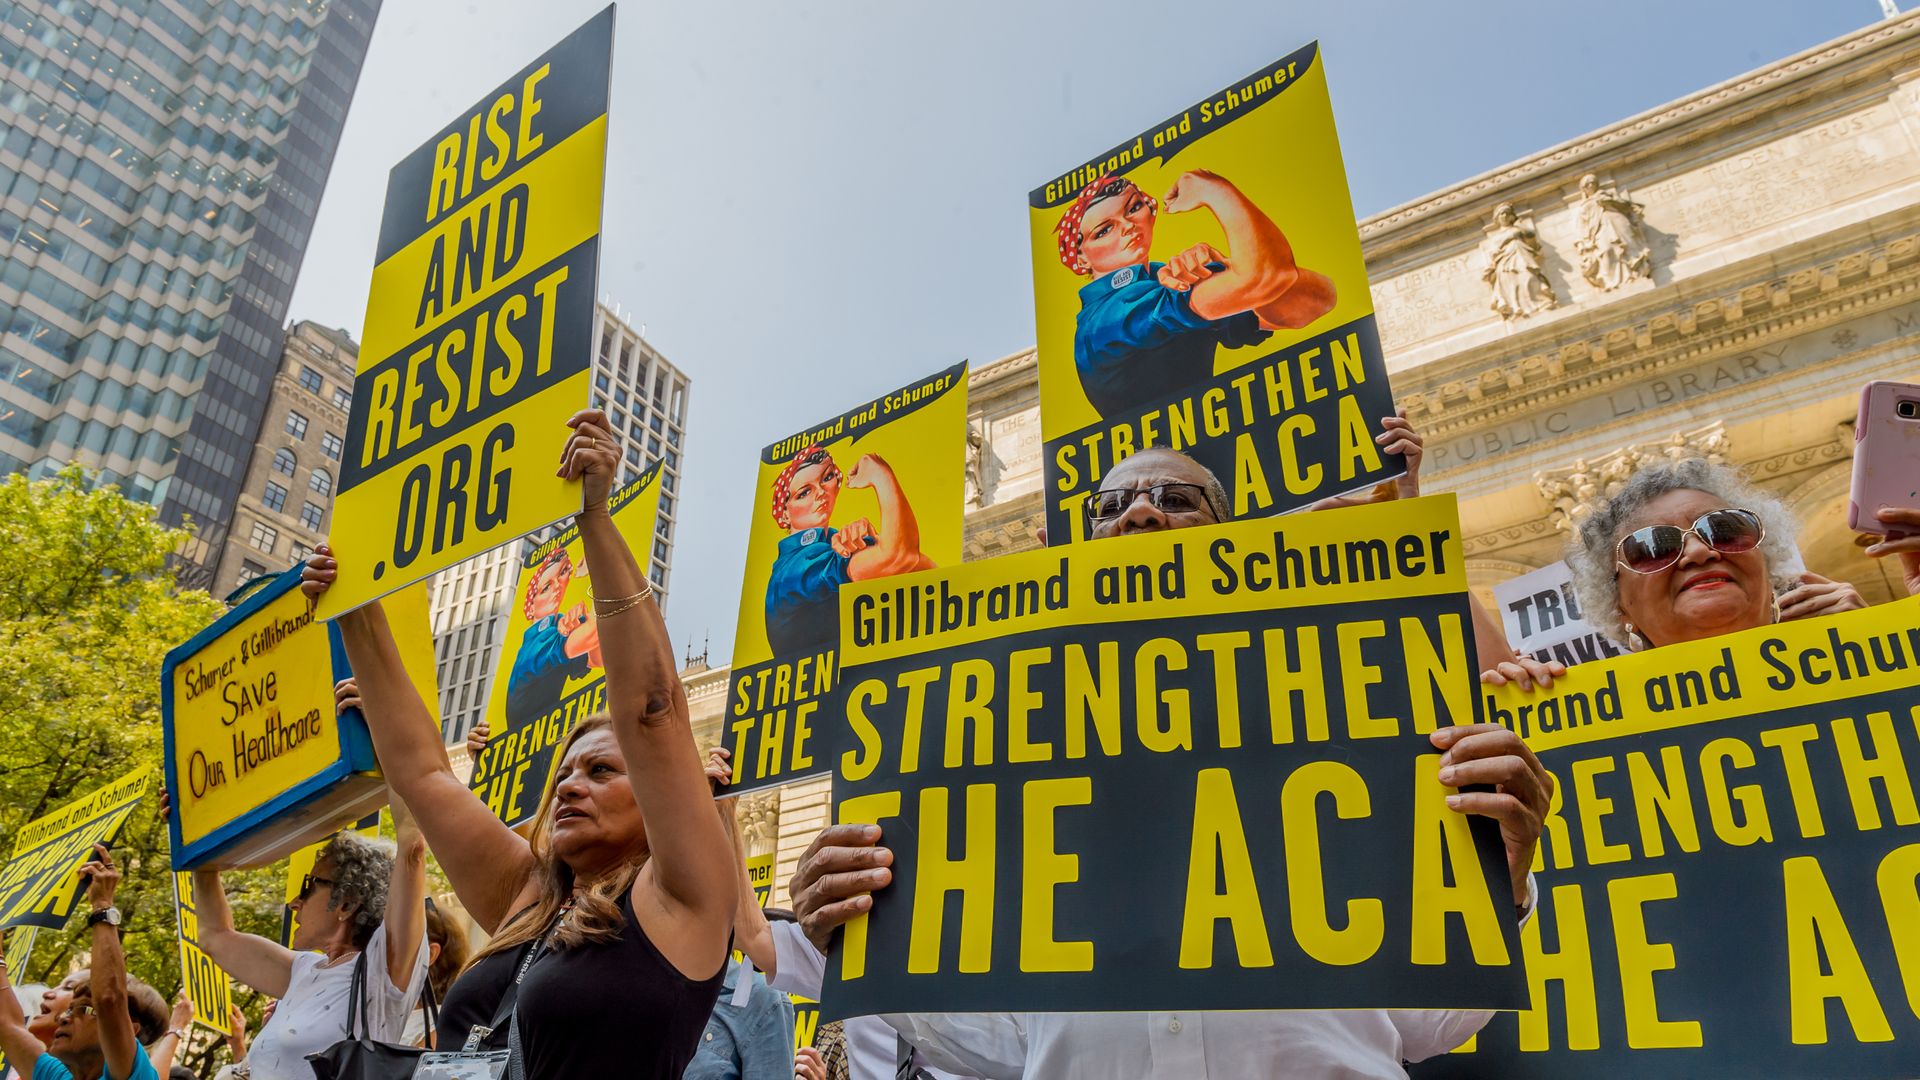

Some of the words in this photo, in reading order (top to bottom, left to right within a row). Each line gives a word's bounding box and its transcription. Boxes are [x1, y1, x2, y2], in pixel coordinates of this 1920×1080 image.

[426, 62, 550, 224] RISE
[1045, 137, 1144, 204] Gillibrand
[1153, 113, 1191, 148] and
[1200, 61, 1297, 123] Schumer
[415, 183, 530, 330] AND
[361, 265, 569, 470] RESIST
[771, 417, 843, 461] Gillibrand
[850, 402, 877, 429] and
[884, 374, 952, 414] Schumer
[1431, 411, 1571, 469] PUBLIC
[1607, 344, 1789, 417] LIBRARY
[373, 422, 515, 581] .ORG
[607, 471, 653, 512] Schumer
[1234, 394, 1383, 517] ACA
[853, 559, 1069, 648] Gillibrand
[1094, 544, 1186, 606] and
[1212, 529, 1452, 596] Schumer
[241, 639, 249, 665] &
[734, 650, 835, 717] STREN
[841, 613, 1475, 781] STRENGTHEN
[1645, 648, 1742, 714] and
[232, 708, 321, 778] Healthcare
[475, 681, 610, 783] STRENGTHE
[732, 700, 819, 785] THE
[1531, 705, 1920, 873] RENGTH
[18, 809, 71, 851] Gillibrand
[72, 796, 95, 825] and
[97, 774, 147, 812] Schumer
[838, 777, 1095, 981] THE
[1178, 753, 1512, 970] ACA
[187, 945, 228, 1029] NOW
[1450, 872, 1704, 1054] HE
